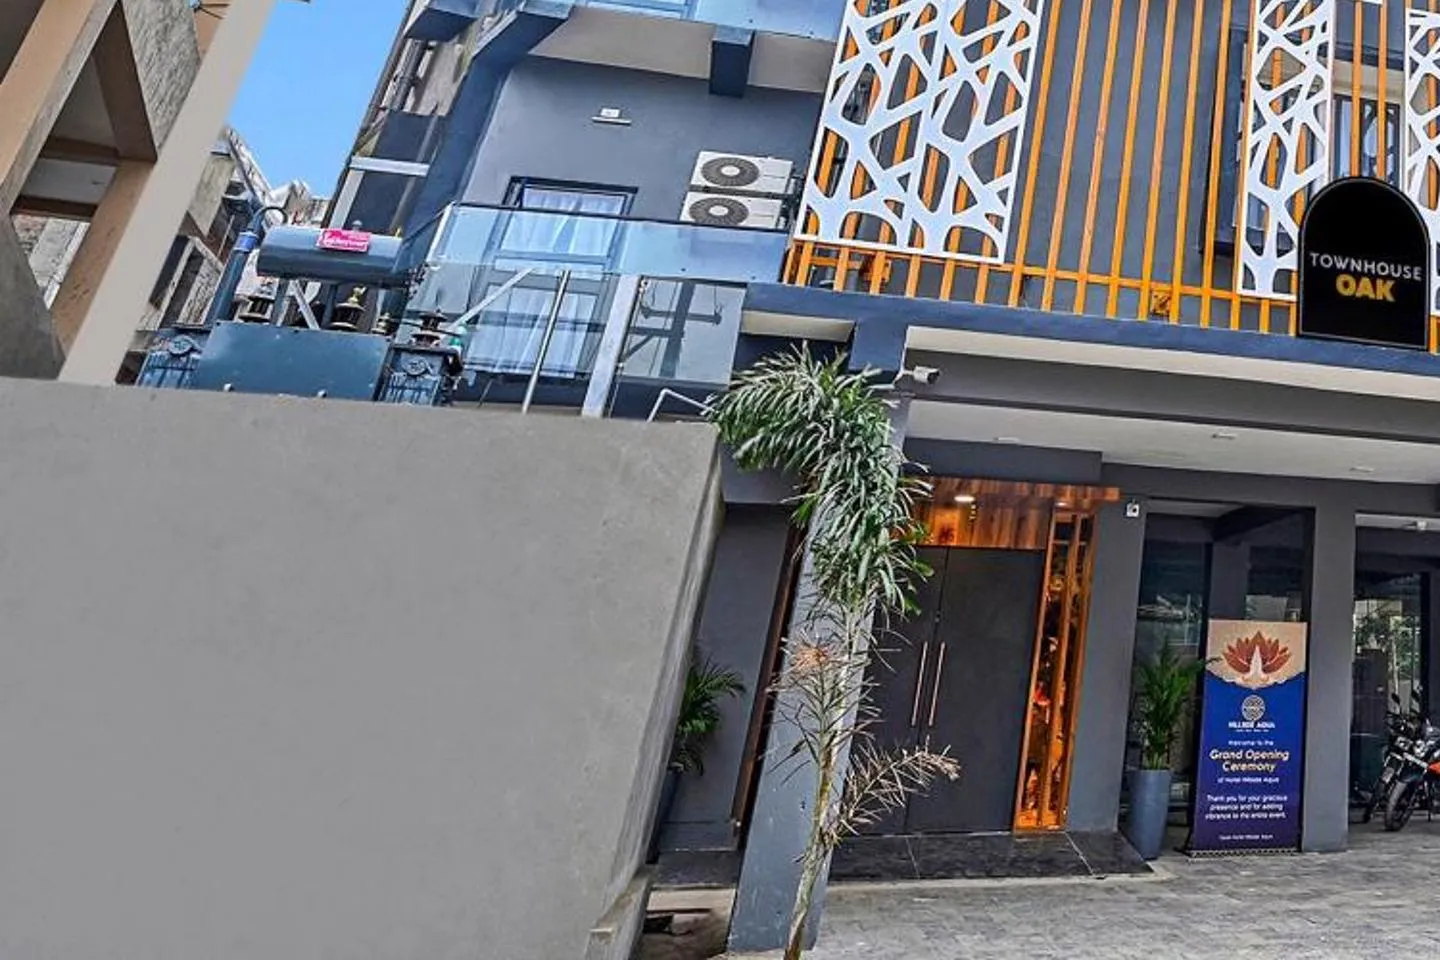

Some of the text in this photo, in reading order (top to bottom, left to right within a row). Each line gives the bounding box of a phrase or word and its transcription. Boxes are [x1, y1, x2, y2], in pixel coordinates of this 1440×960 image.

[1309, 252, 1423, 281] TOWNHOUSE
[1335, 273, 1396, 302] OAK
[1209, 749, 1290, 762] Grand Opening
[1222, 761, 1277, 773] Ceremony
